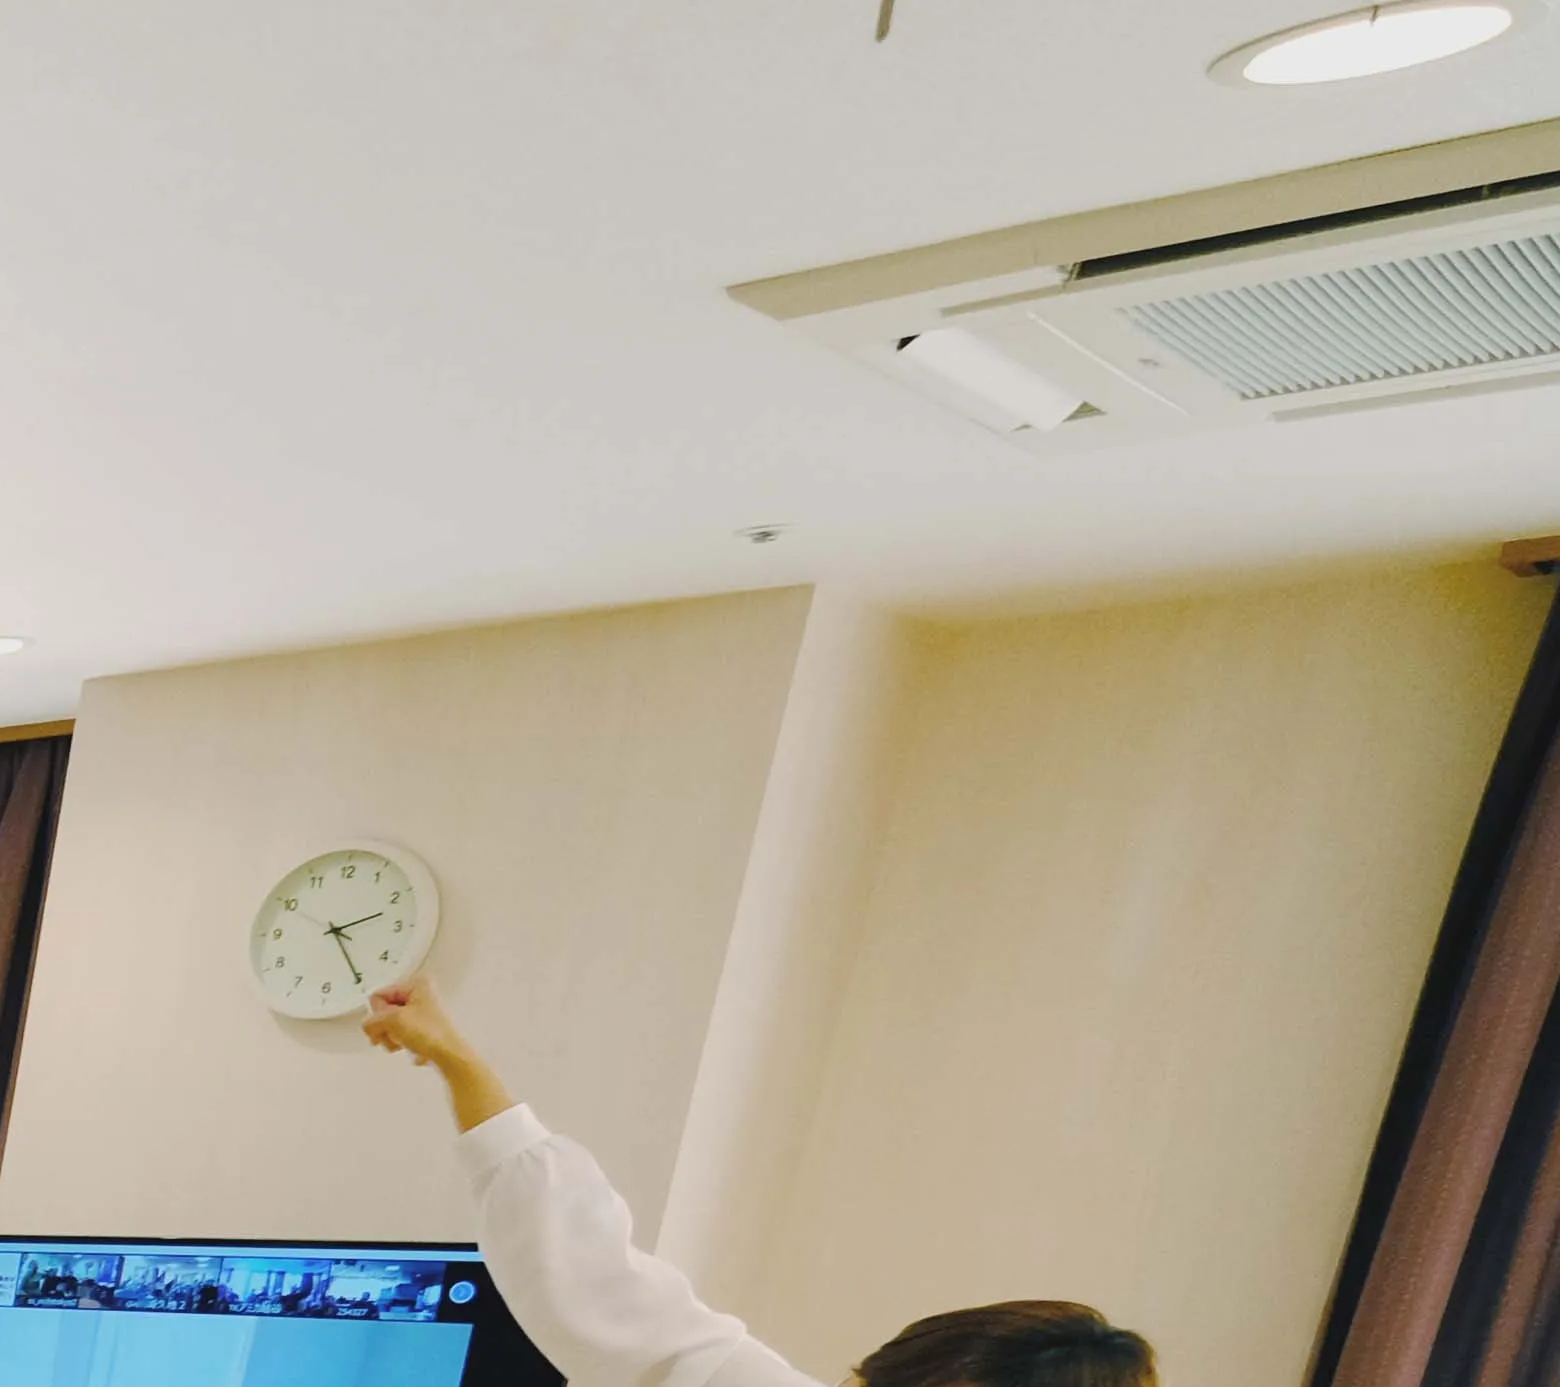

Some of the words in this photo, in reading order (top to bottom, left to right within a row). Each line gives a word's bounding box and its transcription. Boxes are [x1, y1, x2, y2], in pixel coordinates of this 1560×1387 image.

[340, 865, 356, 879] 12
[374, 872, 381, 883] 1
[310, 876, 324, 889] 11
[389, 891, 401, 904] 2
[284, 898, 299, 911] 10
[393, 920, 403, 933] 3
[272, 928, 282, 940] 9
[378, 950, 389, 961] 4
[275, 956, 285, 968] 8
[293, 976, 303, 988] 7
[321, 982, 331, 994] 6
